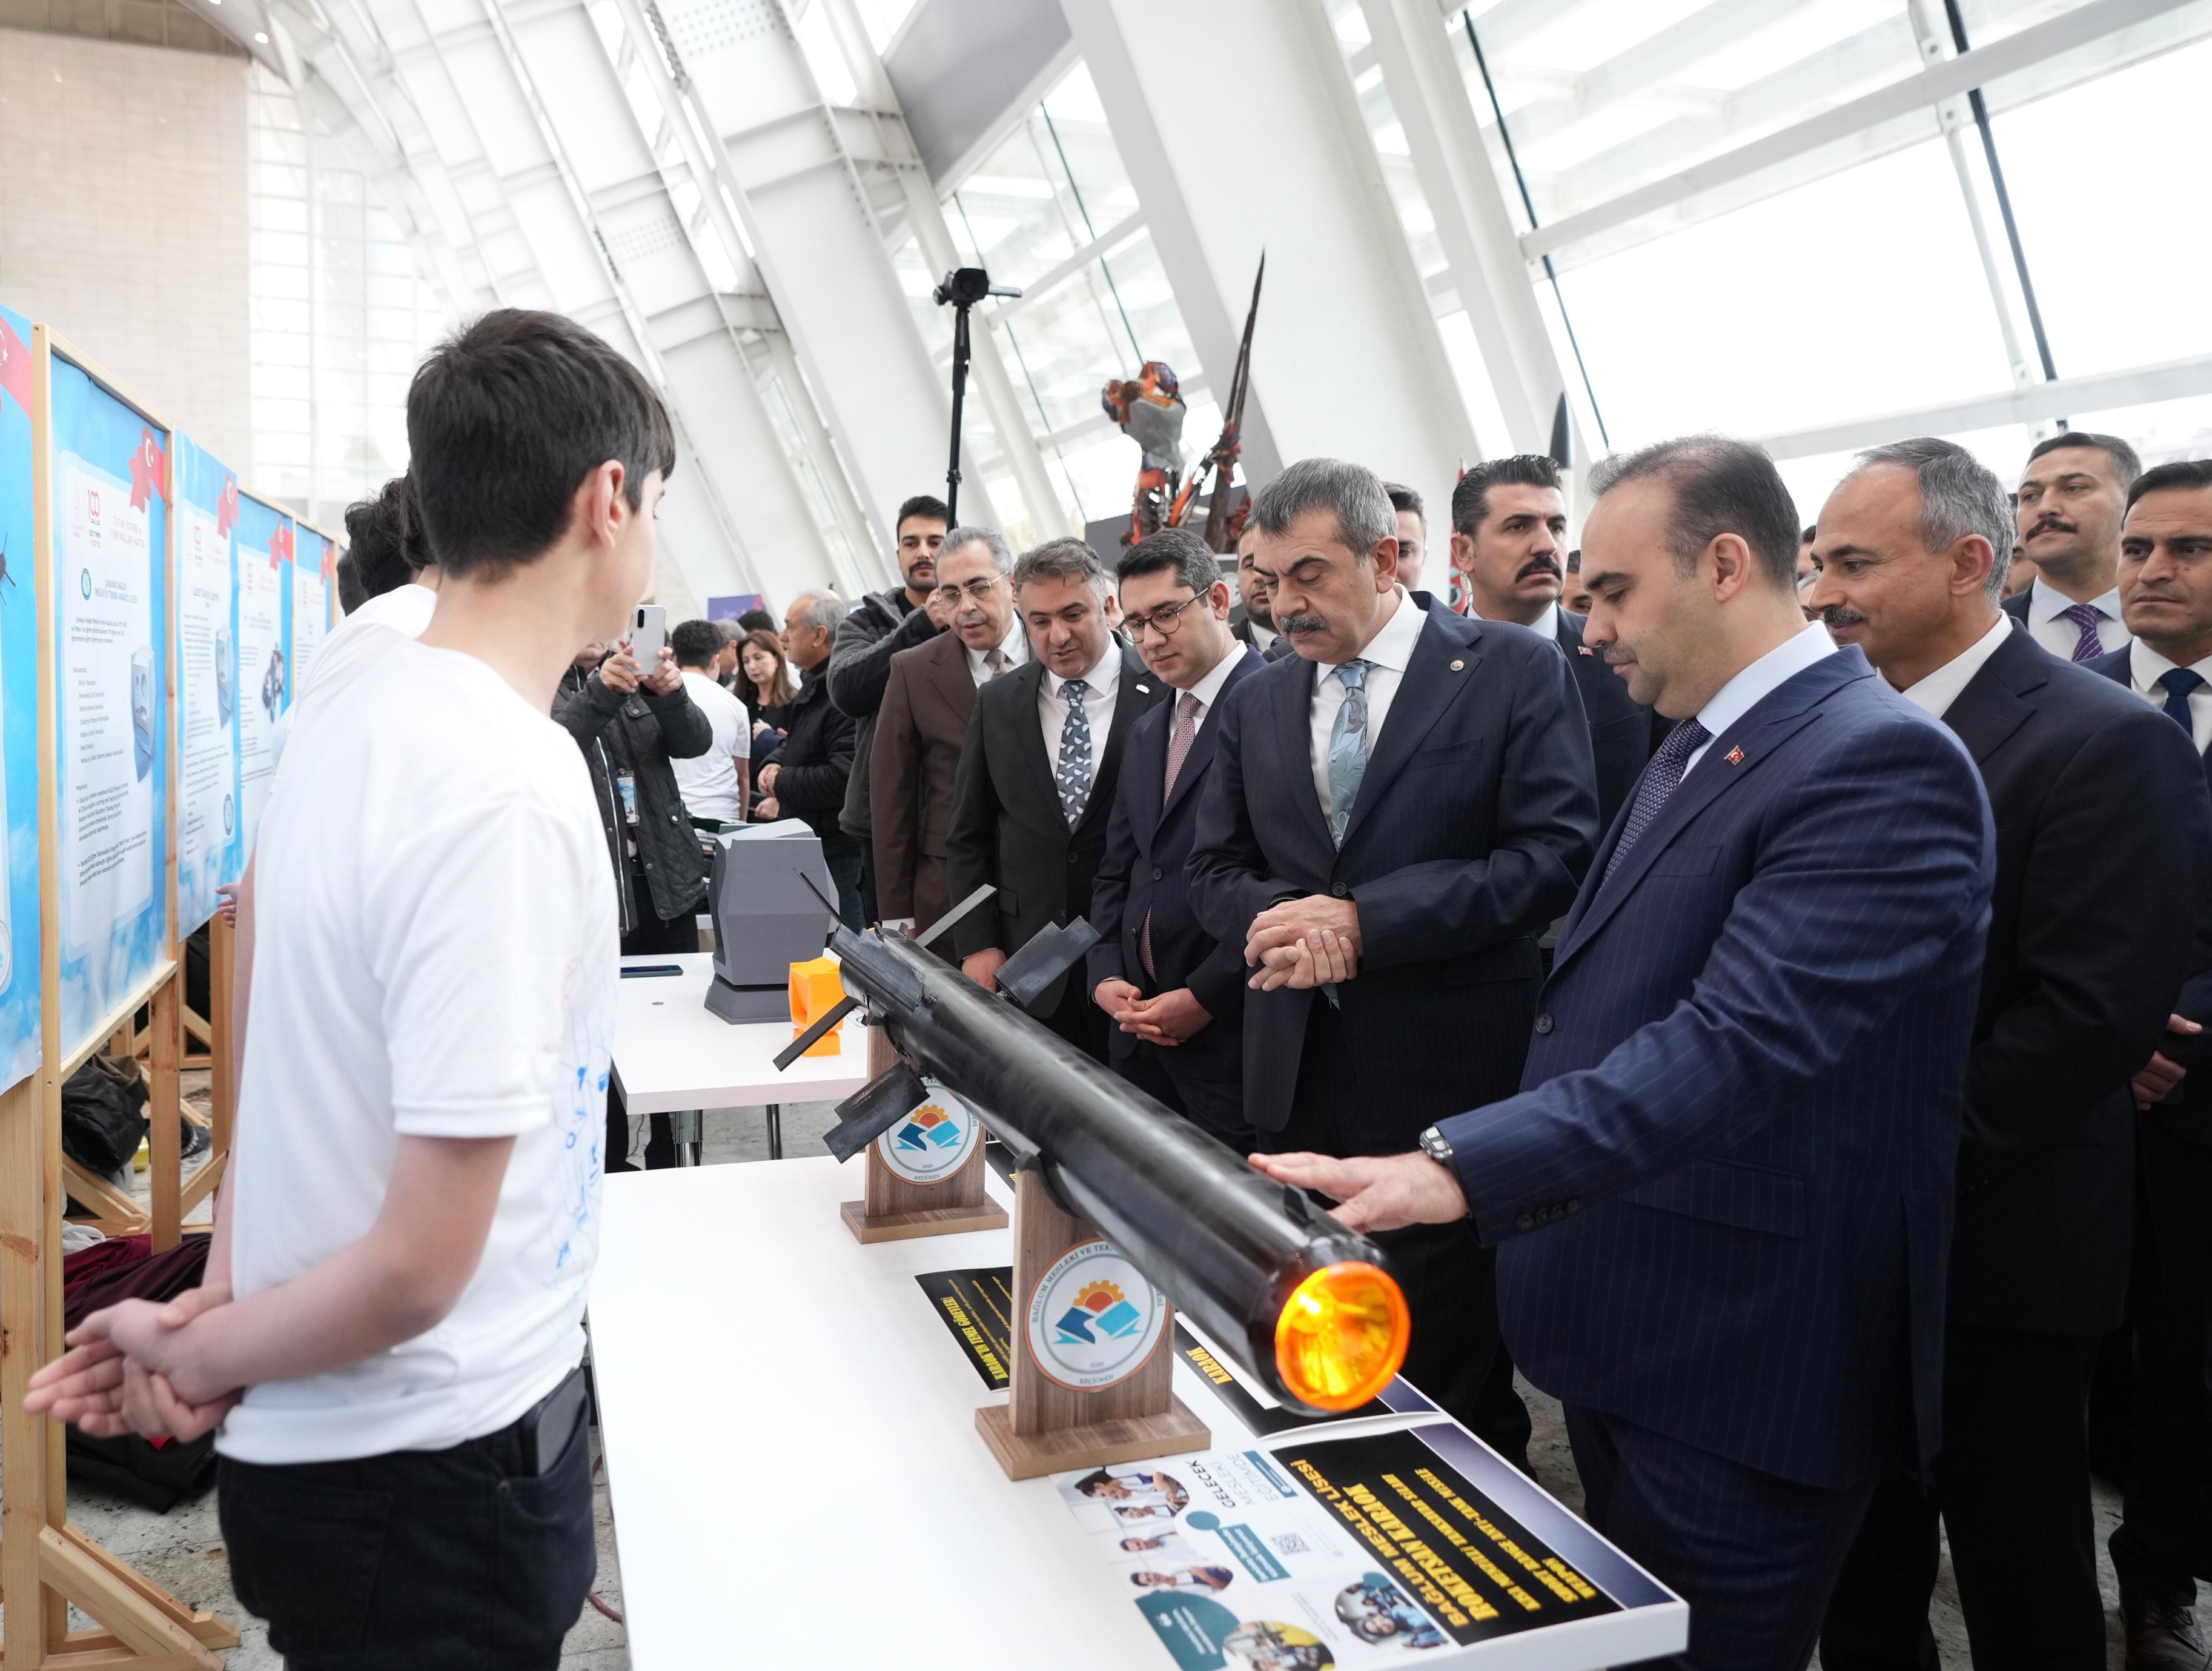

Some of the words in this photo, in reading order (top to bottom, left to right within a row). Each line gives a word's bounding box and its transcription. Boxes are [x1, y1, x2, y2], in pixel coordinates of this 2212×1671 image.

[1032, 1284, 1048, 1323] BAĞLUM
[1046, 1251, 1079, 1283] MESLEKİ
[1081, 1246, 1092, 1255] VE
[961, 1326, 984, 1346] TEMEL
[1079, 1374, 1114, 1385] KEÇİÖREN
[1188, 1347, 1233, 1384] KARAOK
[1186, 1460, 1236, 1508] GELECEK
[1291, 1459, 1342, 1500] LİSESİ
[1334, 1500, 1400, 1558] MESLEK
[1343, 1483, 1416, 1541] KARAOK
[1498, 1539, 1541, 1571] RANGE
[1393, 1558, 1469, 1627] BAĞLUM
[1400, 1540, 1499, 1621] ROKETSAN
[1543, 1557, 1596, 1599] WEAPON
